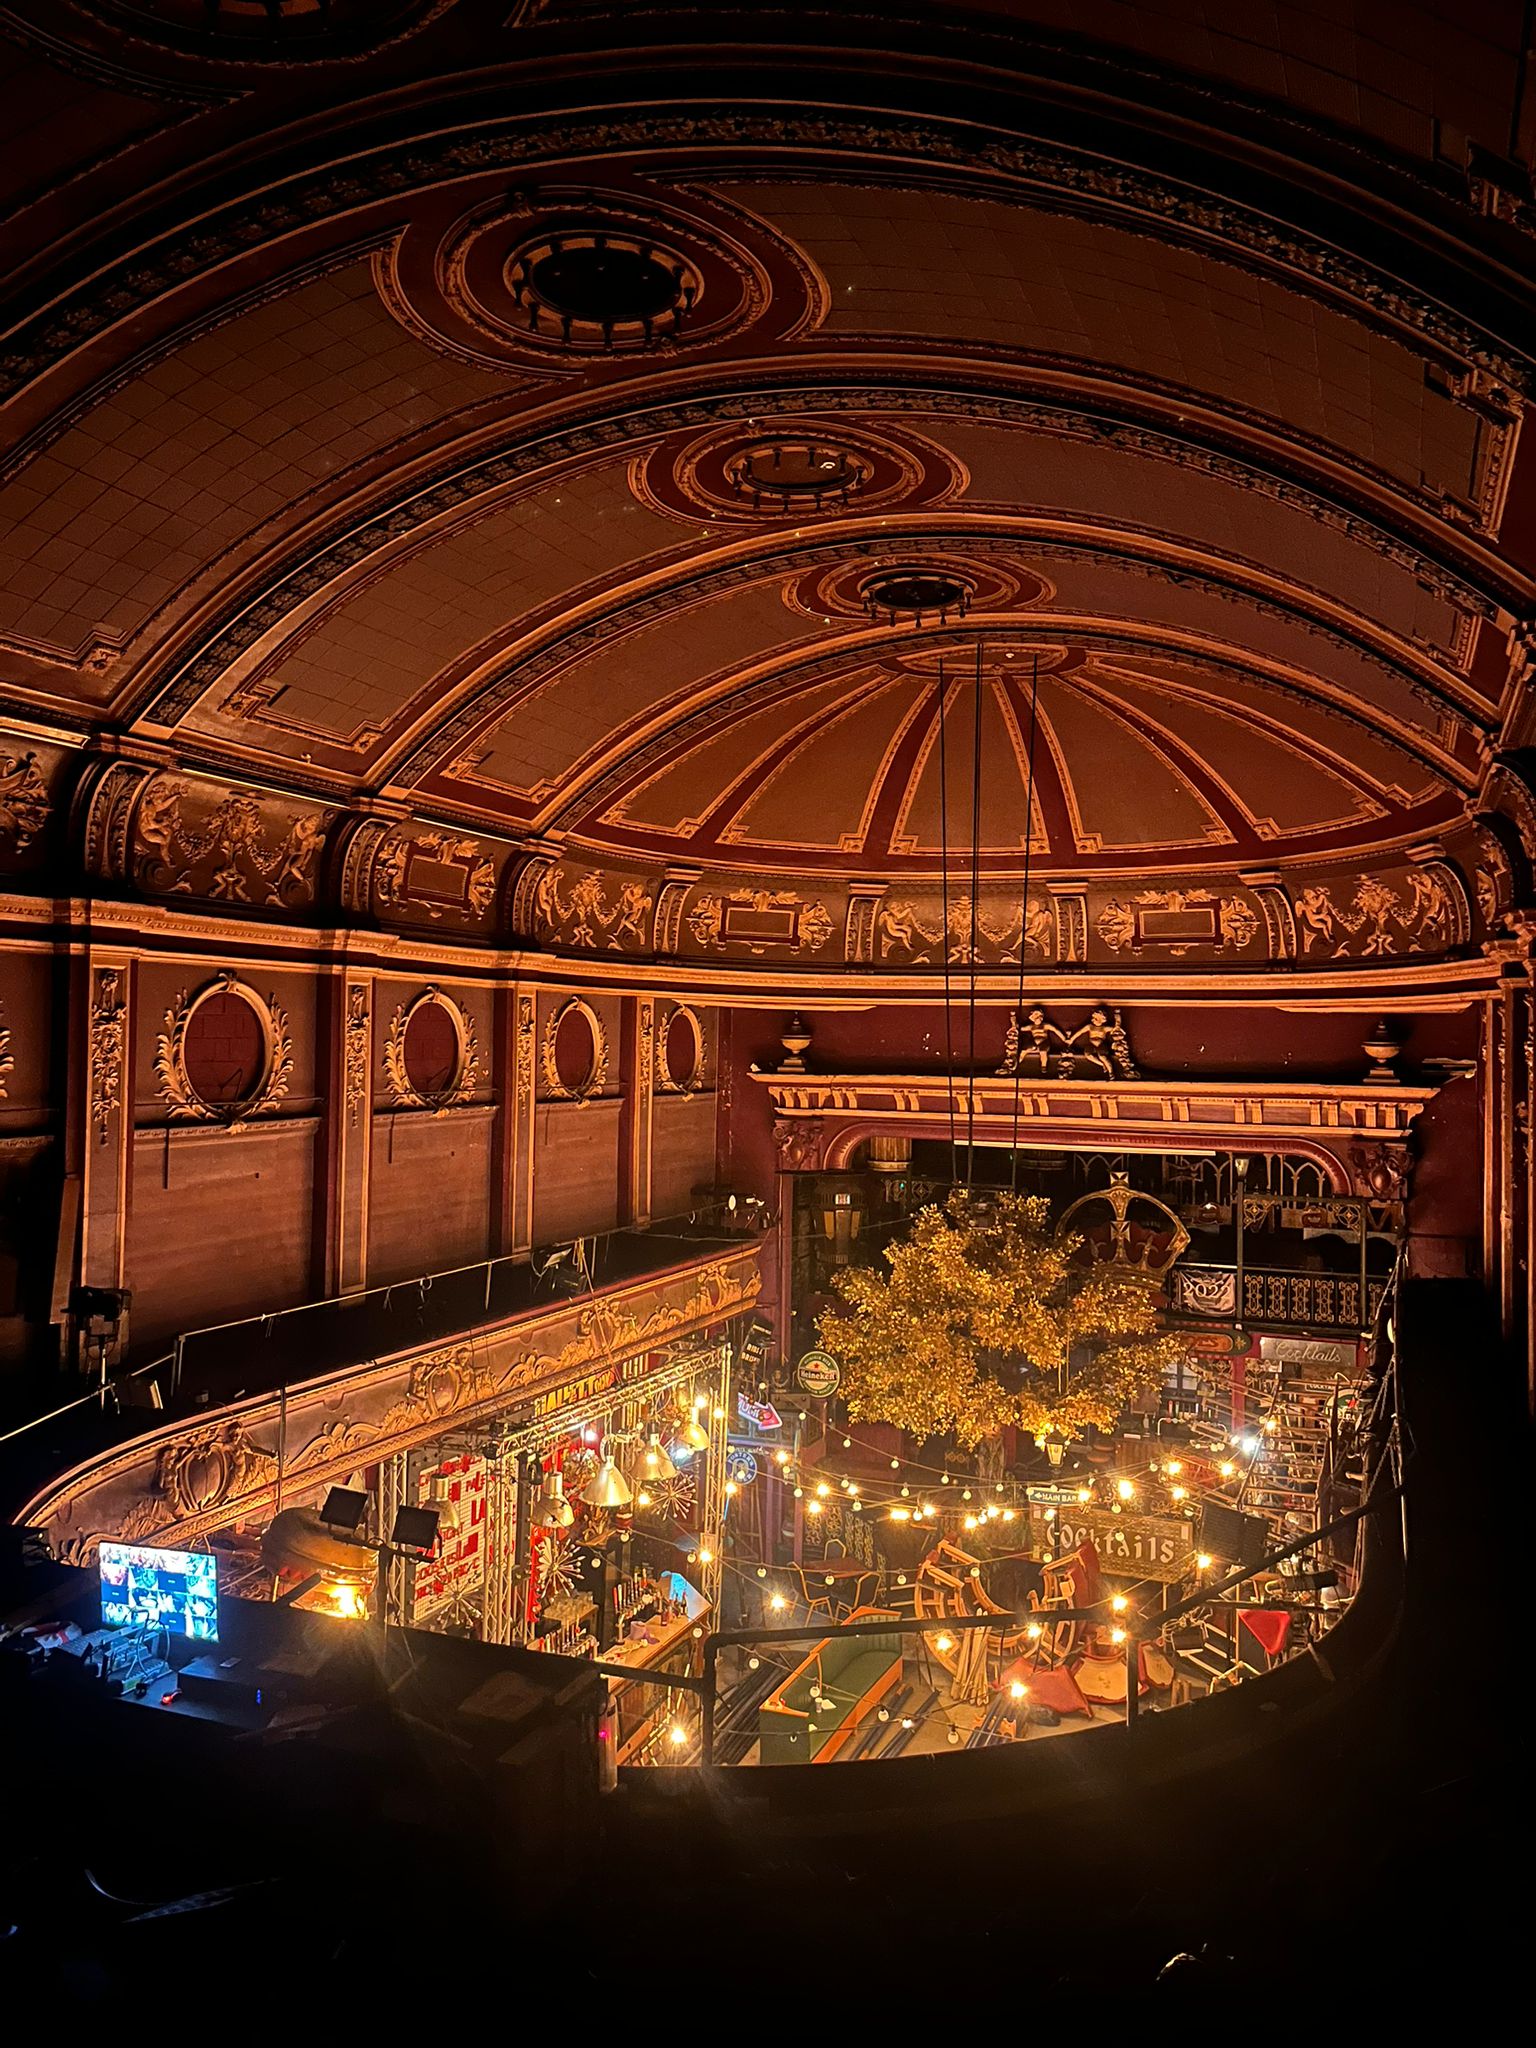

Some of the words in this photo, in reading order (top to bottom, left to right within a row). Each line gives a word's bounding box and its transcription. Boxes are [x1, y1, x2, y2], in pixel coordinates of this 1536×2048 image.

[1183, 1283, 1230, 1298] 2022
[1276, 1341, 1341, 1362] Cocktails
[800, 1370, 835, 1380] Heineken
[1042, 1493, 1061, 1502] MAIN
[1046, 1521, 1175, 1564] Cocktails
